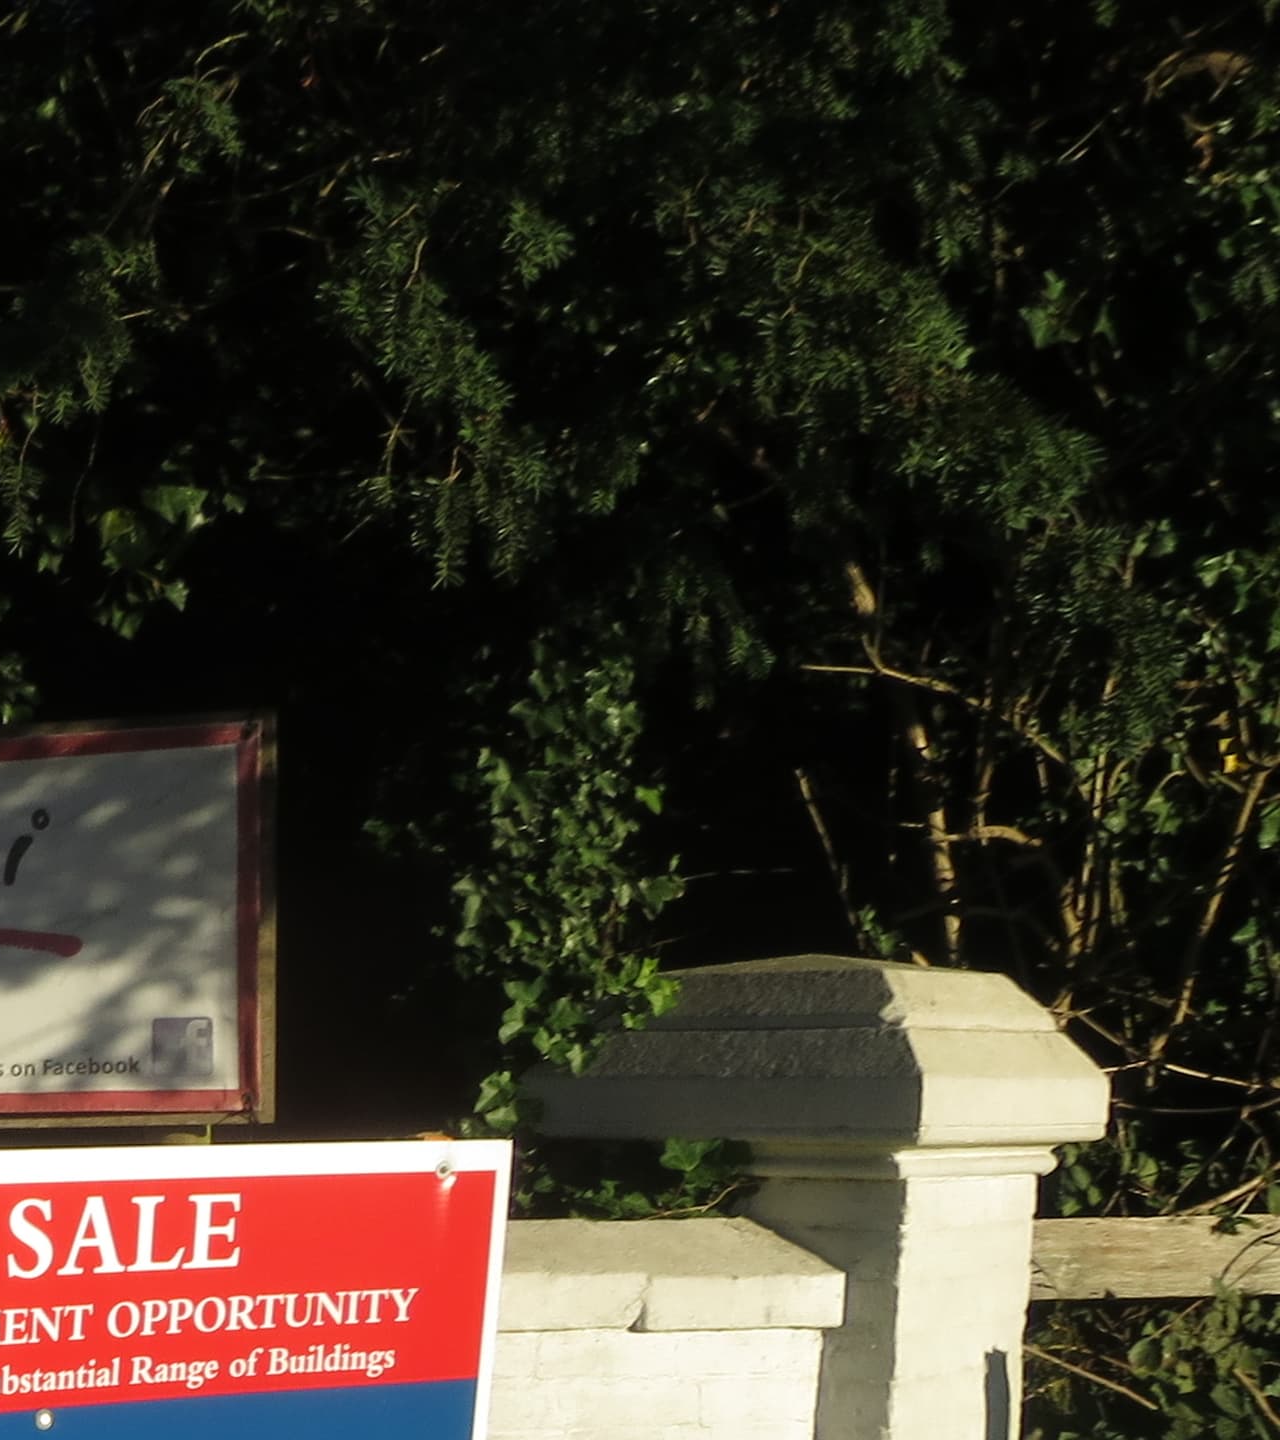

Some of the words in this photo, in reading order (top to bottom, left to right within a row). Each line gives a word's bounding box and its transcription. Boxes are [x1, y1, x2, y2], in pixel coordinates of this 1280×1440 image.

[10, 1063, 36, 1077] on
[42, 1055, 141, 1075] Facebook
[7, 1191, 241, 1281] SALE
[107, 1288, 419, 1338] OPPORTUNITY
[130, 1354, 219, 1390] Range
[230, 1347, 263, 1378] of
[267, 1344, 396, 1379] Buildings
